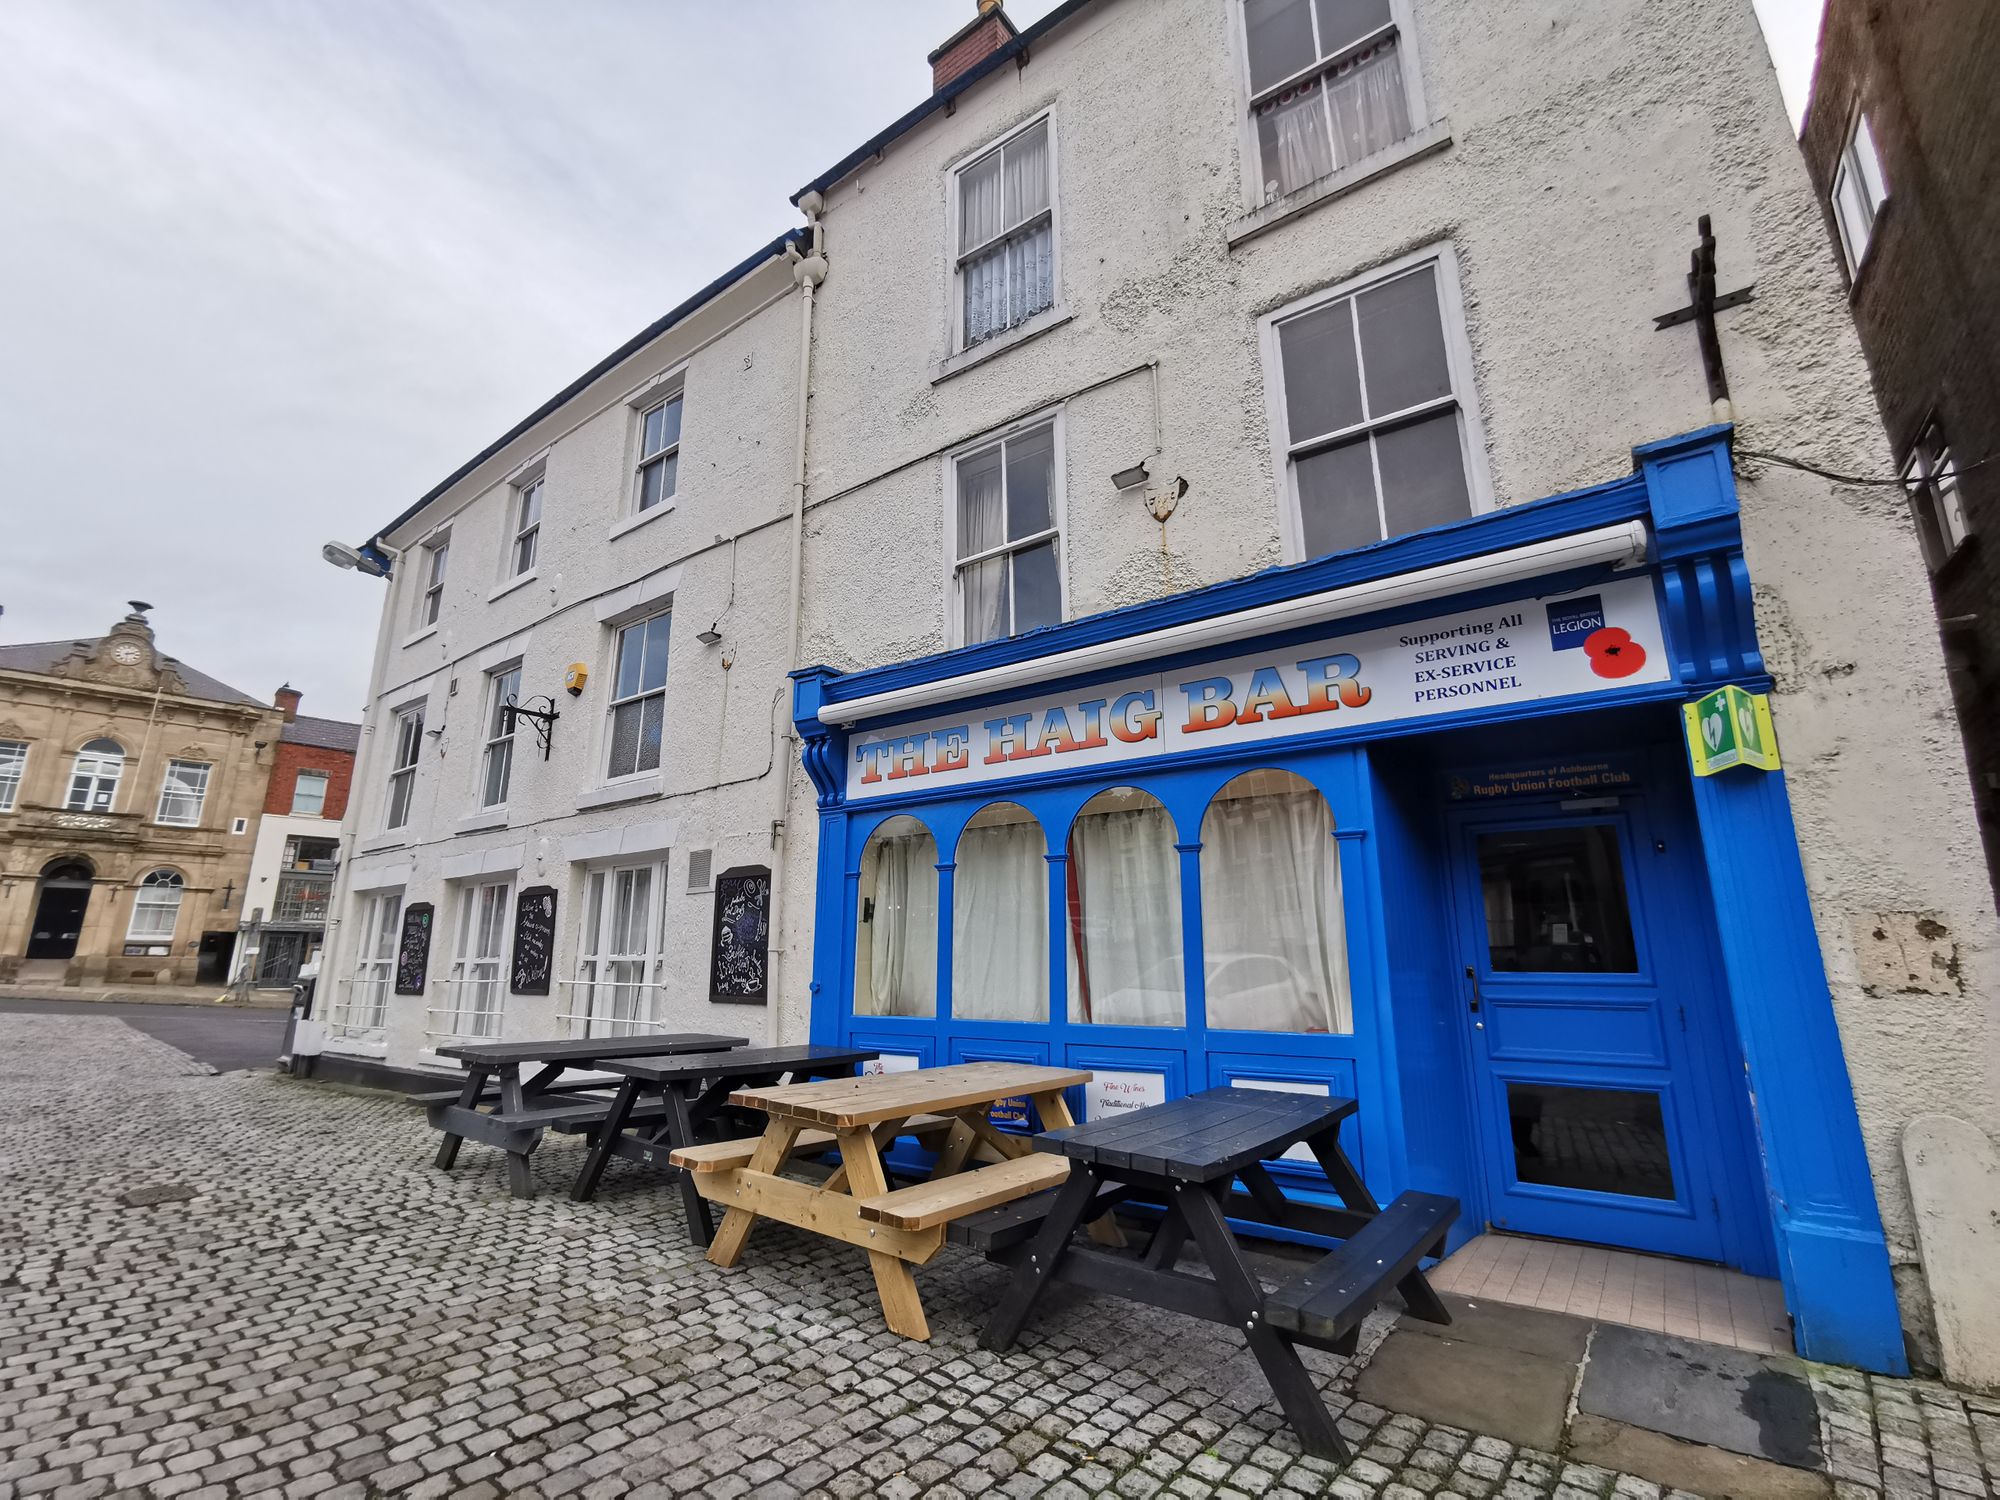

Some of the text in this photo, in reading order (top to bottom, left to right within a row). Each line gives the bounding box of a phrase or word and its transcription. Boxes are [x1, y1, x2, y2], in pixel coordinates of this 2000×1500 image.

[1399, 614, 1523, 648] Supporting All
[1552, 617, 1602, 634] LEGION
[1415, 637, 1510, 664] SERVING &
[1414, 656, 1517, 683] EX-SERVICE
[1414, 676, 1522, 703] PERSONNEL
[856, 652, 1372, 784] THE HAIG BAR
[1473, 771, 1631, 796] Rugby Union Football Club
[1488, 769, 1546, 781] Headquarters
[1547, 767, 1557, 776] of
[990, 1110, 1012, 1119] ootball
[1008, 1098, 1026, 1108] Union
